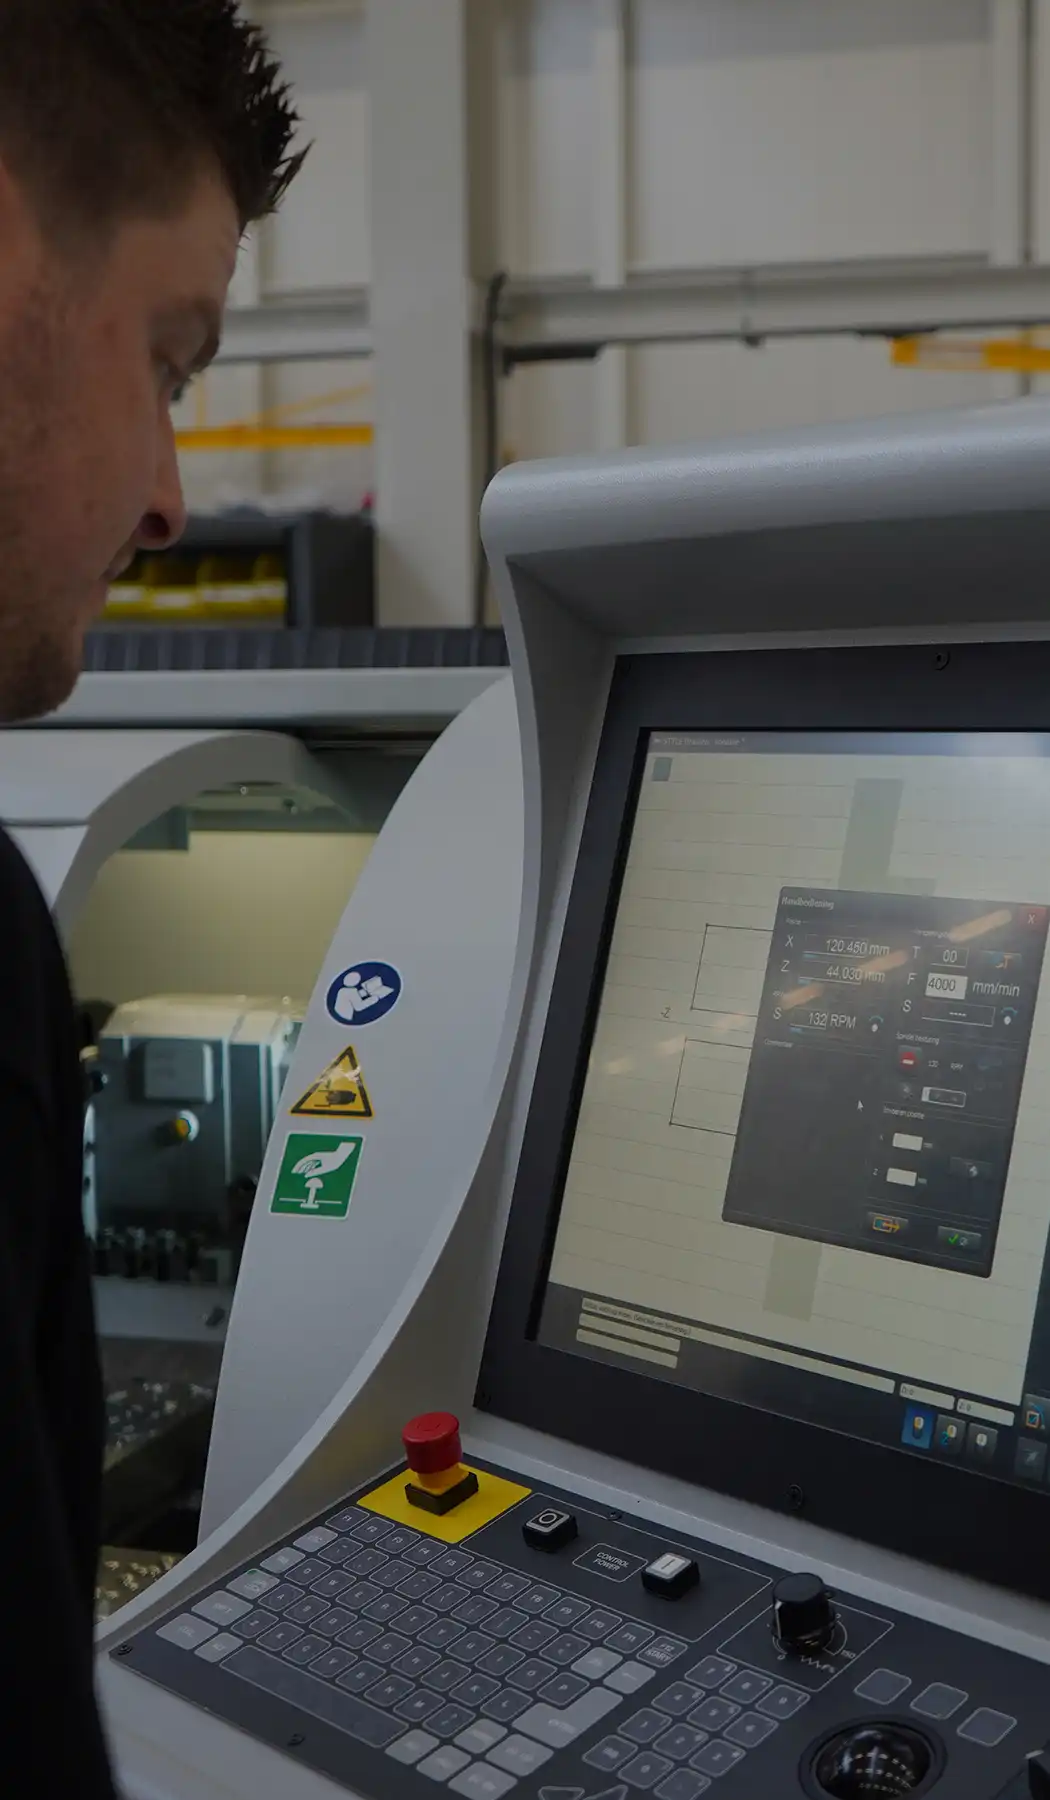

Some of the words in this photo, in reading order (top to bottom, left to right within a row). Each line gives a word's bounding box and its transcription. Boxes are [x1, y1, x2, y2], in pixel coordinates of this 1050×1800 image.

[785, 934, 794, 948] X
[826, 939, 867, 954] 120.450
[869, 944, 890, 955] mm
[912, 946, 921, 959] T
[942, 949, 958, 963] 00
[780, 960, 790, 972] Z
[826, 965, 863, 981] 44.030
[907, 972, 918, 985] F
[928, 977, 956, 992] 4000
[972, 981, 1021, 997] mm/min
[902, 999, 912, 1013] S
[772, 1007, 782, 1020] S
[808, 1012, 827, 1026] 132
[830, 1013, 857, 1030] RPM
[593, 1558, 621, 1571] POWER
[596, 1551, 630, 1568] CONTROL
